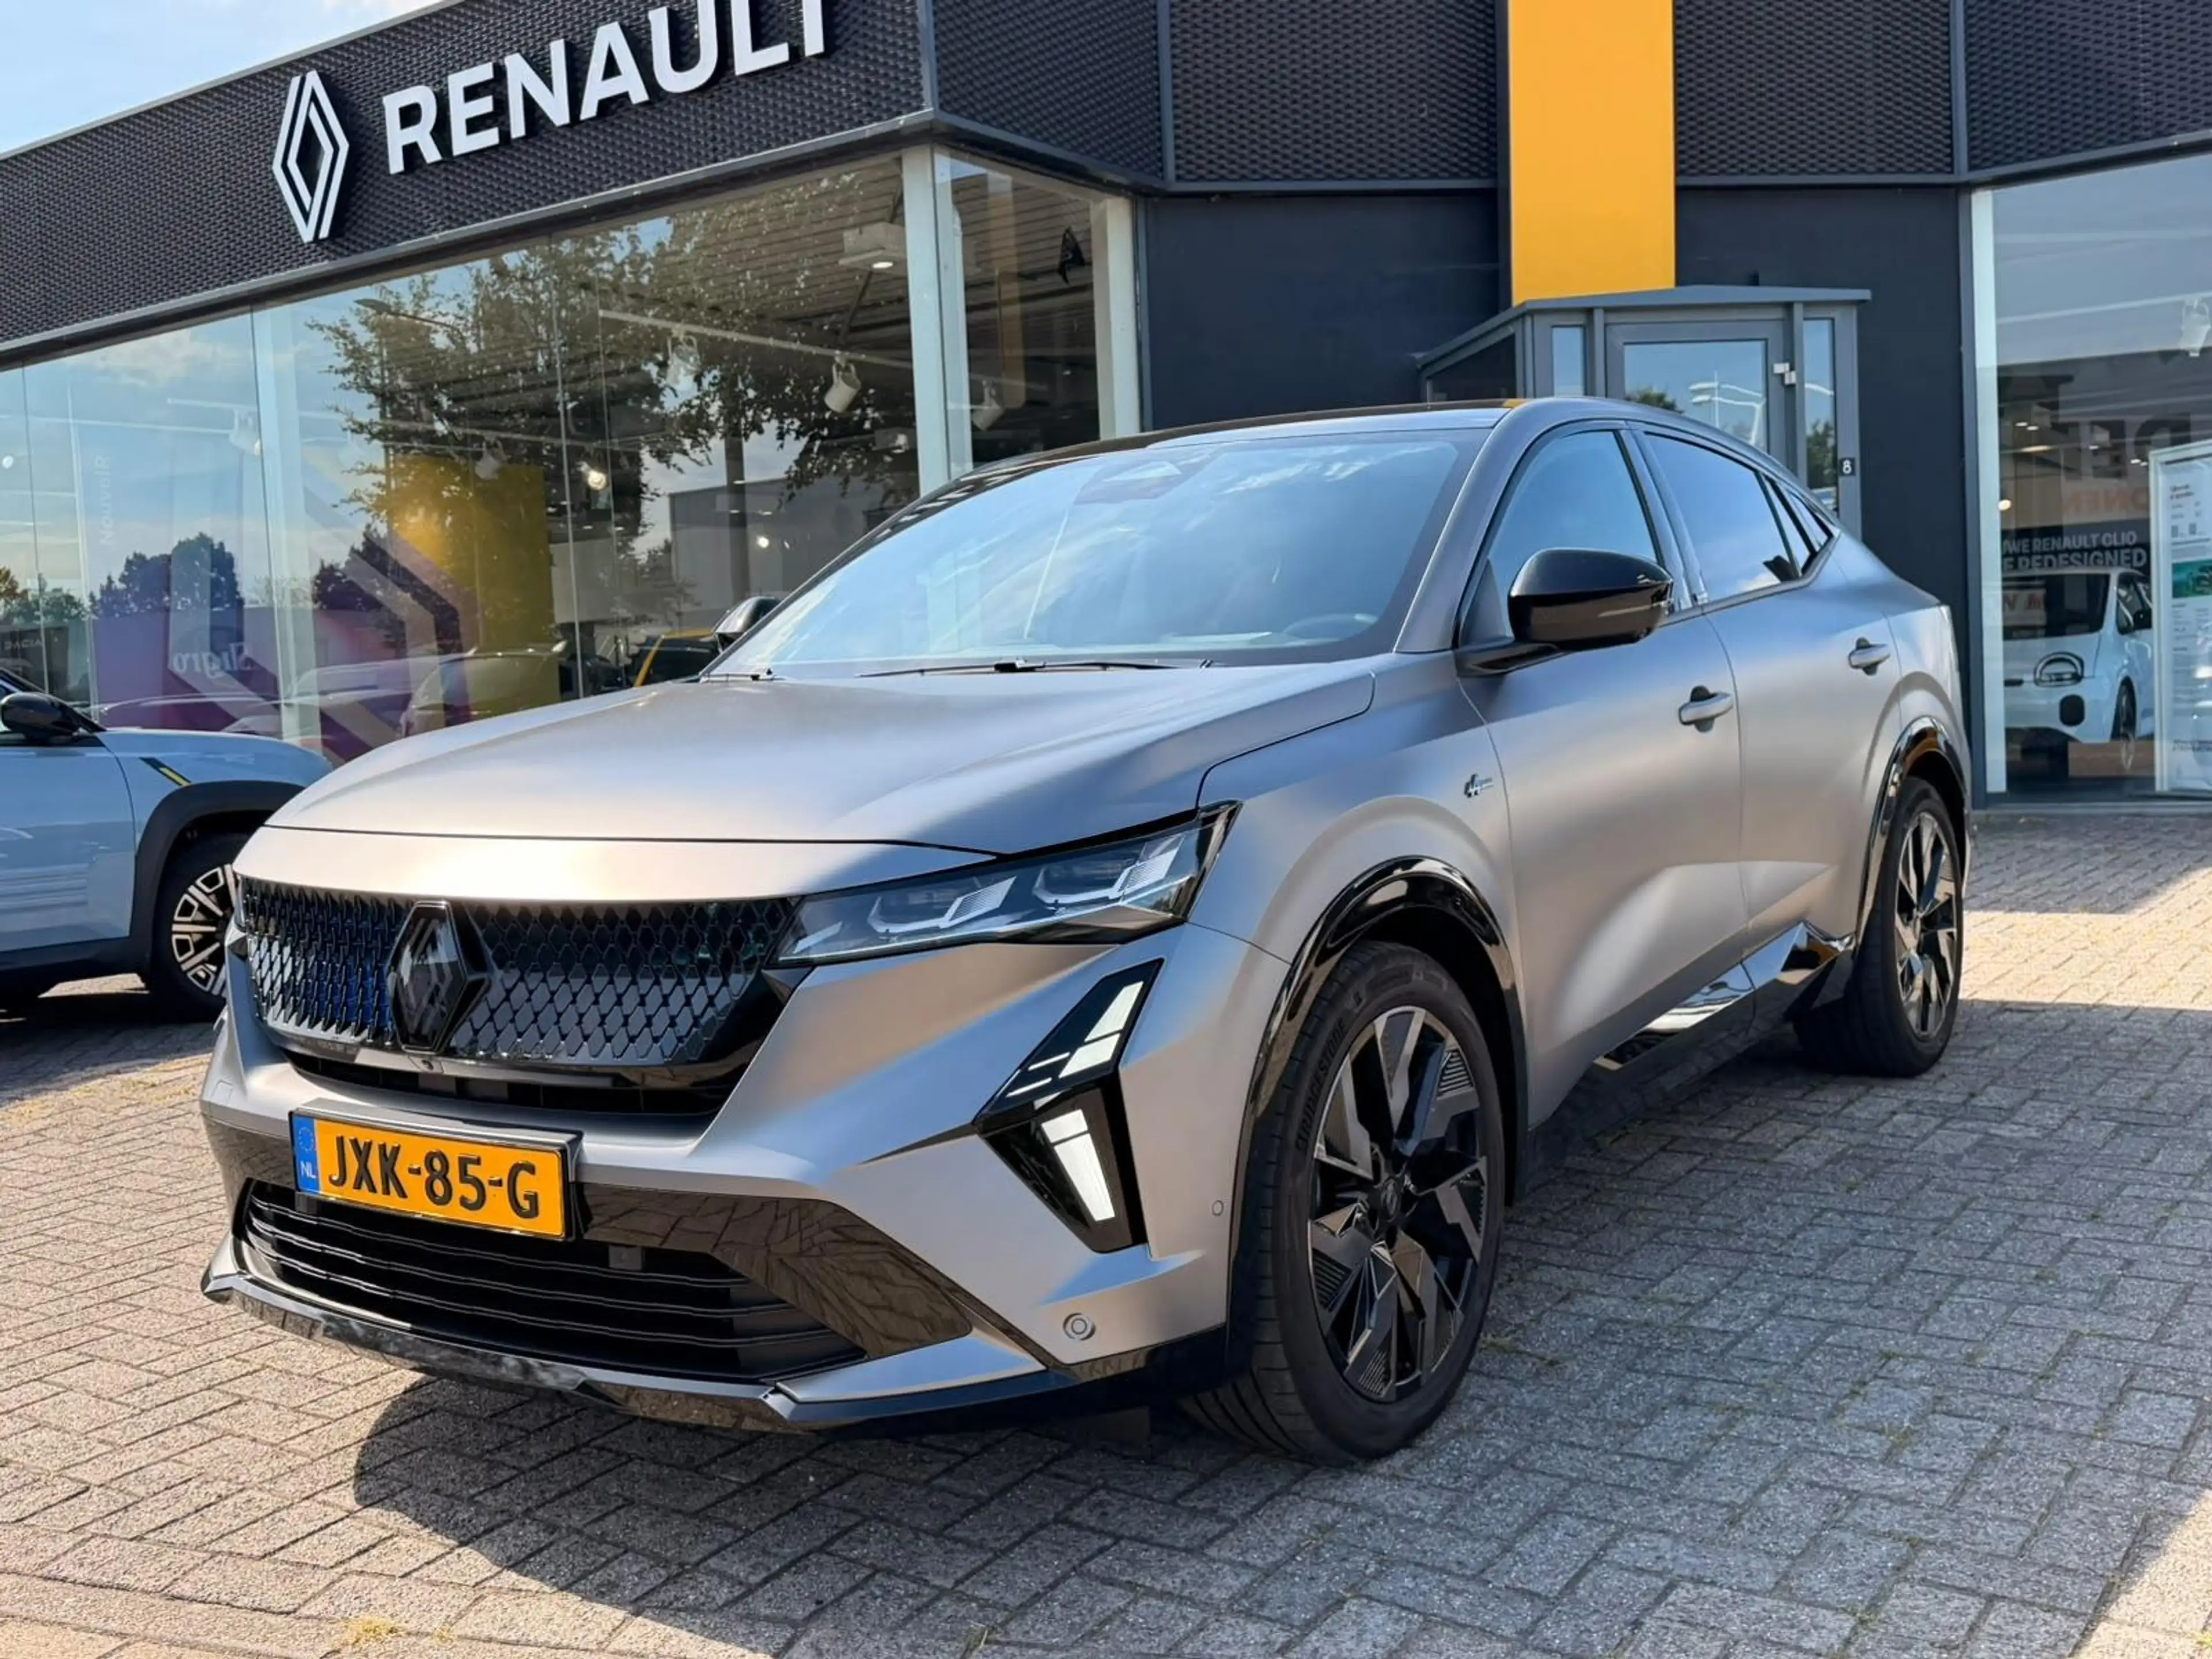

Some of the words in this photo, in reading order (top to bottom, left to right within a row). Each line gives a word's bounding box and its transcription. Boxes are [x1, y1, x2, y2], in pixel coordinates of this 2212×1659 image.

[383, 0, 824, 175] RENAULT
[1842, 459, 1852, 474] 8
[2032, 533, 2100, 553] RENAULT
[2101, 531, 2138, 547] CLIO
[2018, 547, 2147, 571] REDESIGNED
[301, 1161, 317, 1179] NL
[329, 1135, 540, 1219] JXK-85-G
